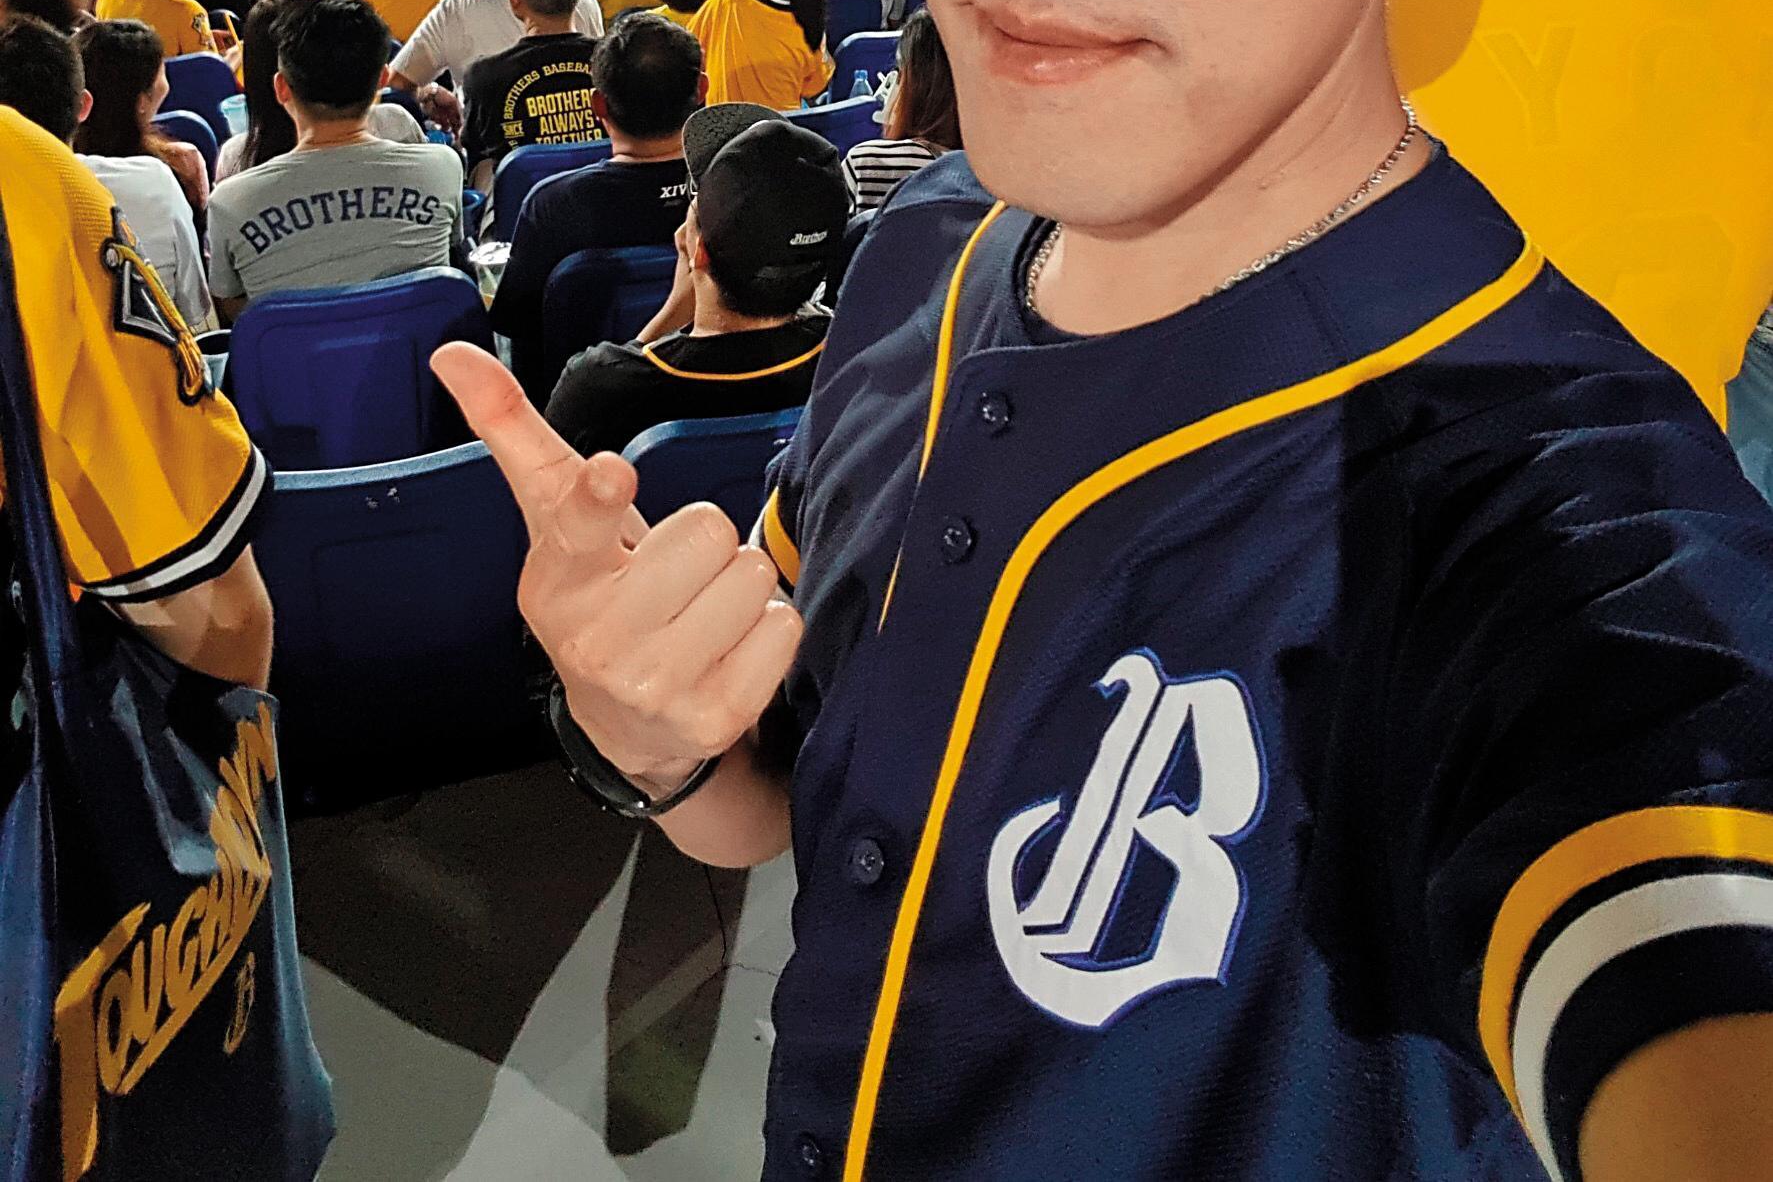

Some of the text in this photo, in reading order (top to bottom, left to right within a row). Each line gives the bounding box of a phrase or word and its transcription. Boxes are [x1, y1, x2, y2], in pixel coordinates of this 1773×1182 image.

[503, 70, 541, 120] BROTHERS
[526, 87, 597, 117] BROTHER
[540, 109, 595, 135] ALWAYS
[239, 186, 441, 255] BROTHERS
